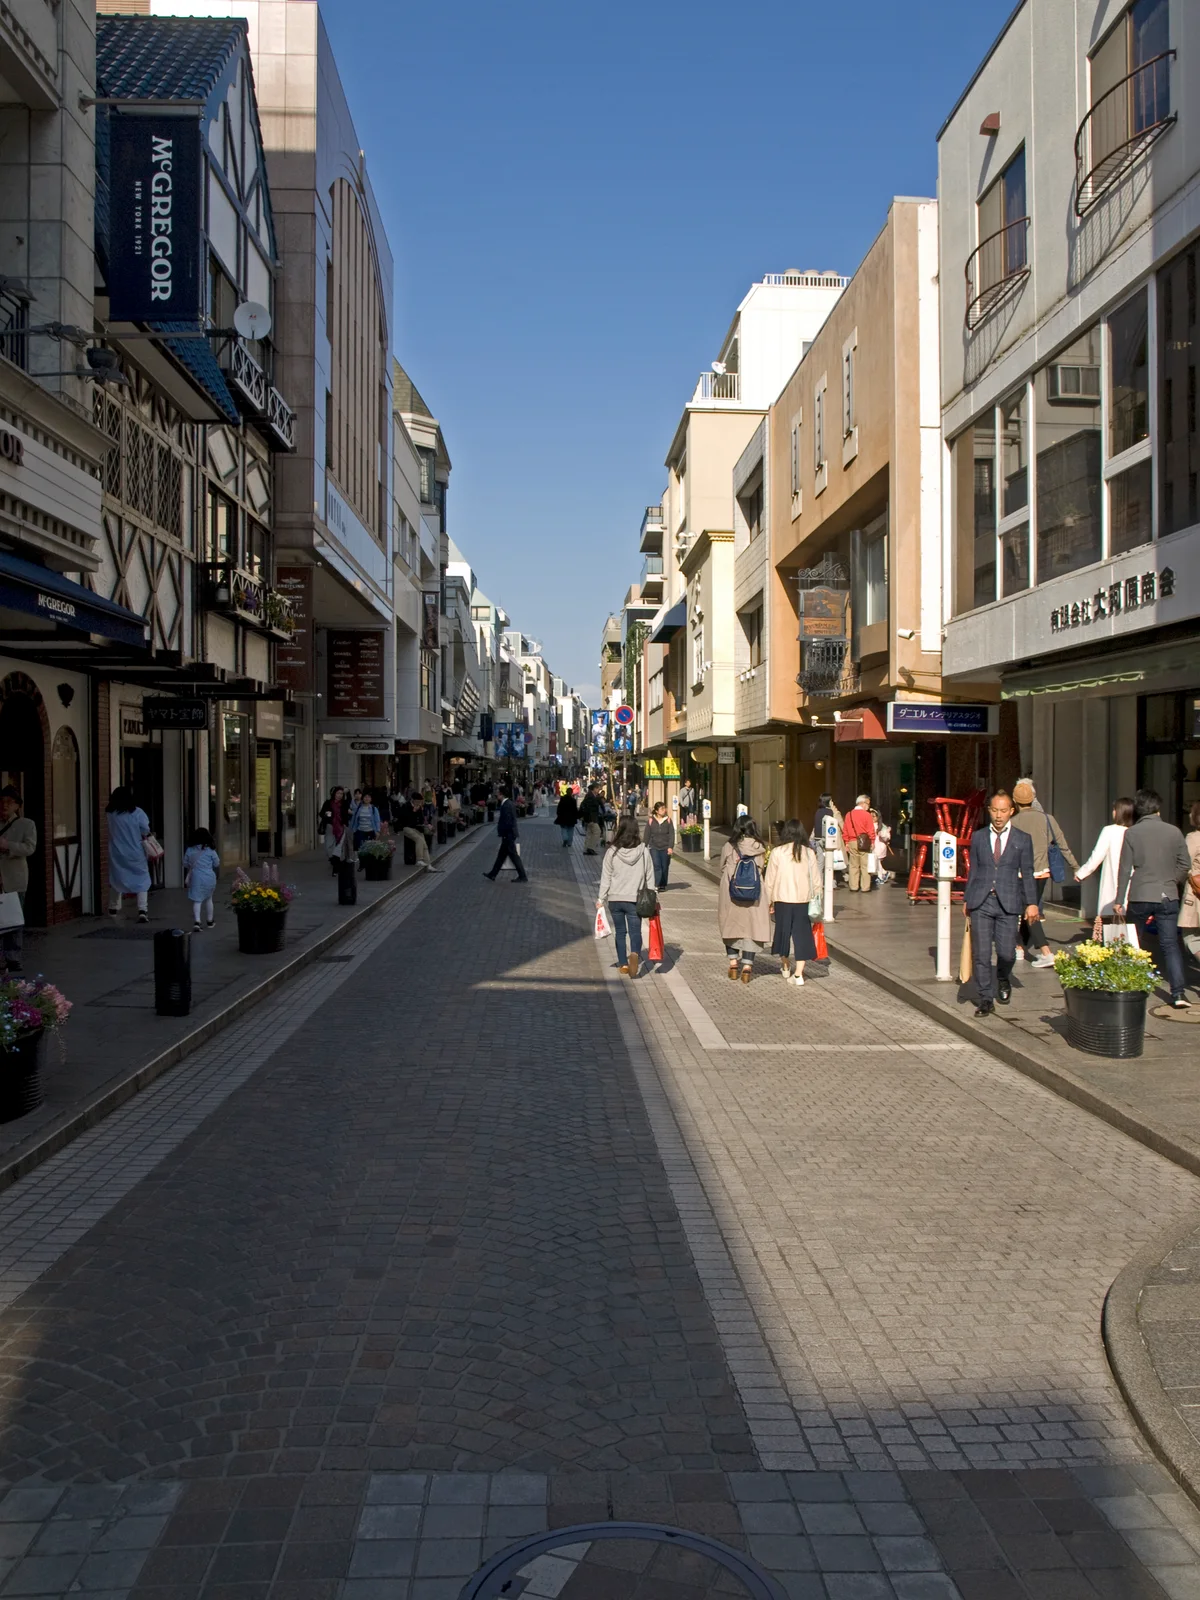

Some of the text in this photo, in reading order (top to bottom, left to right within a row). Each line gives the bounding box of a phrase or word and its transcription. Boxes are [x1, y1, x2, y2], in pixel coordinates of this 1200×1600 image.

[134, 181, 143, 256] NEW YORK 1921
[147, 706, 204, 721] ヤマト宝飾
[898, 707, 982, 721] ダニエル インテリアスタジオ
